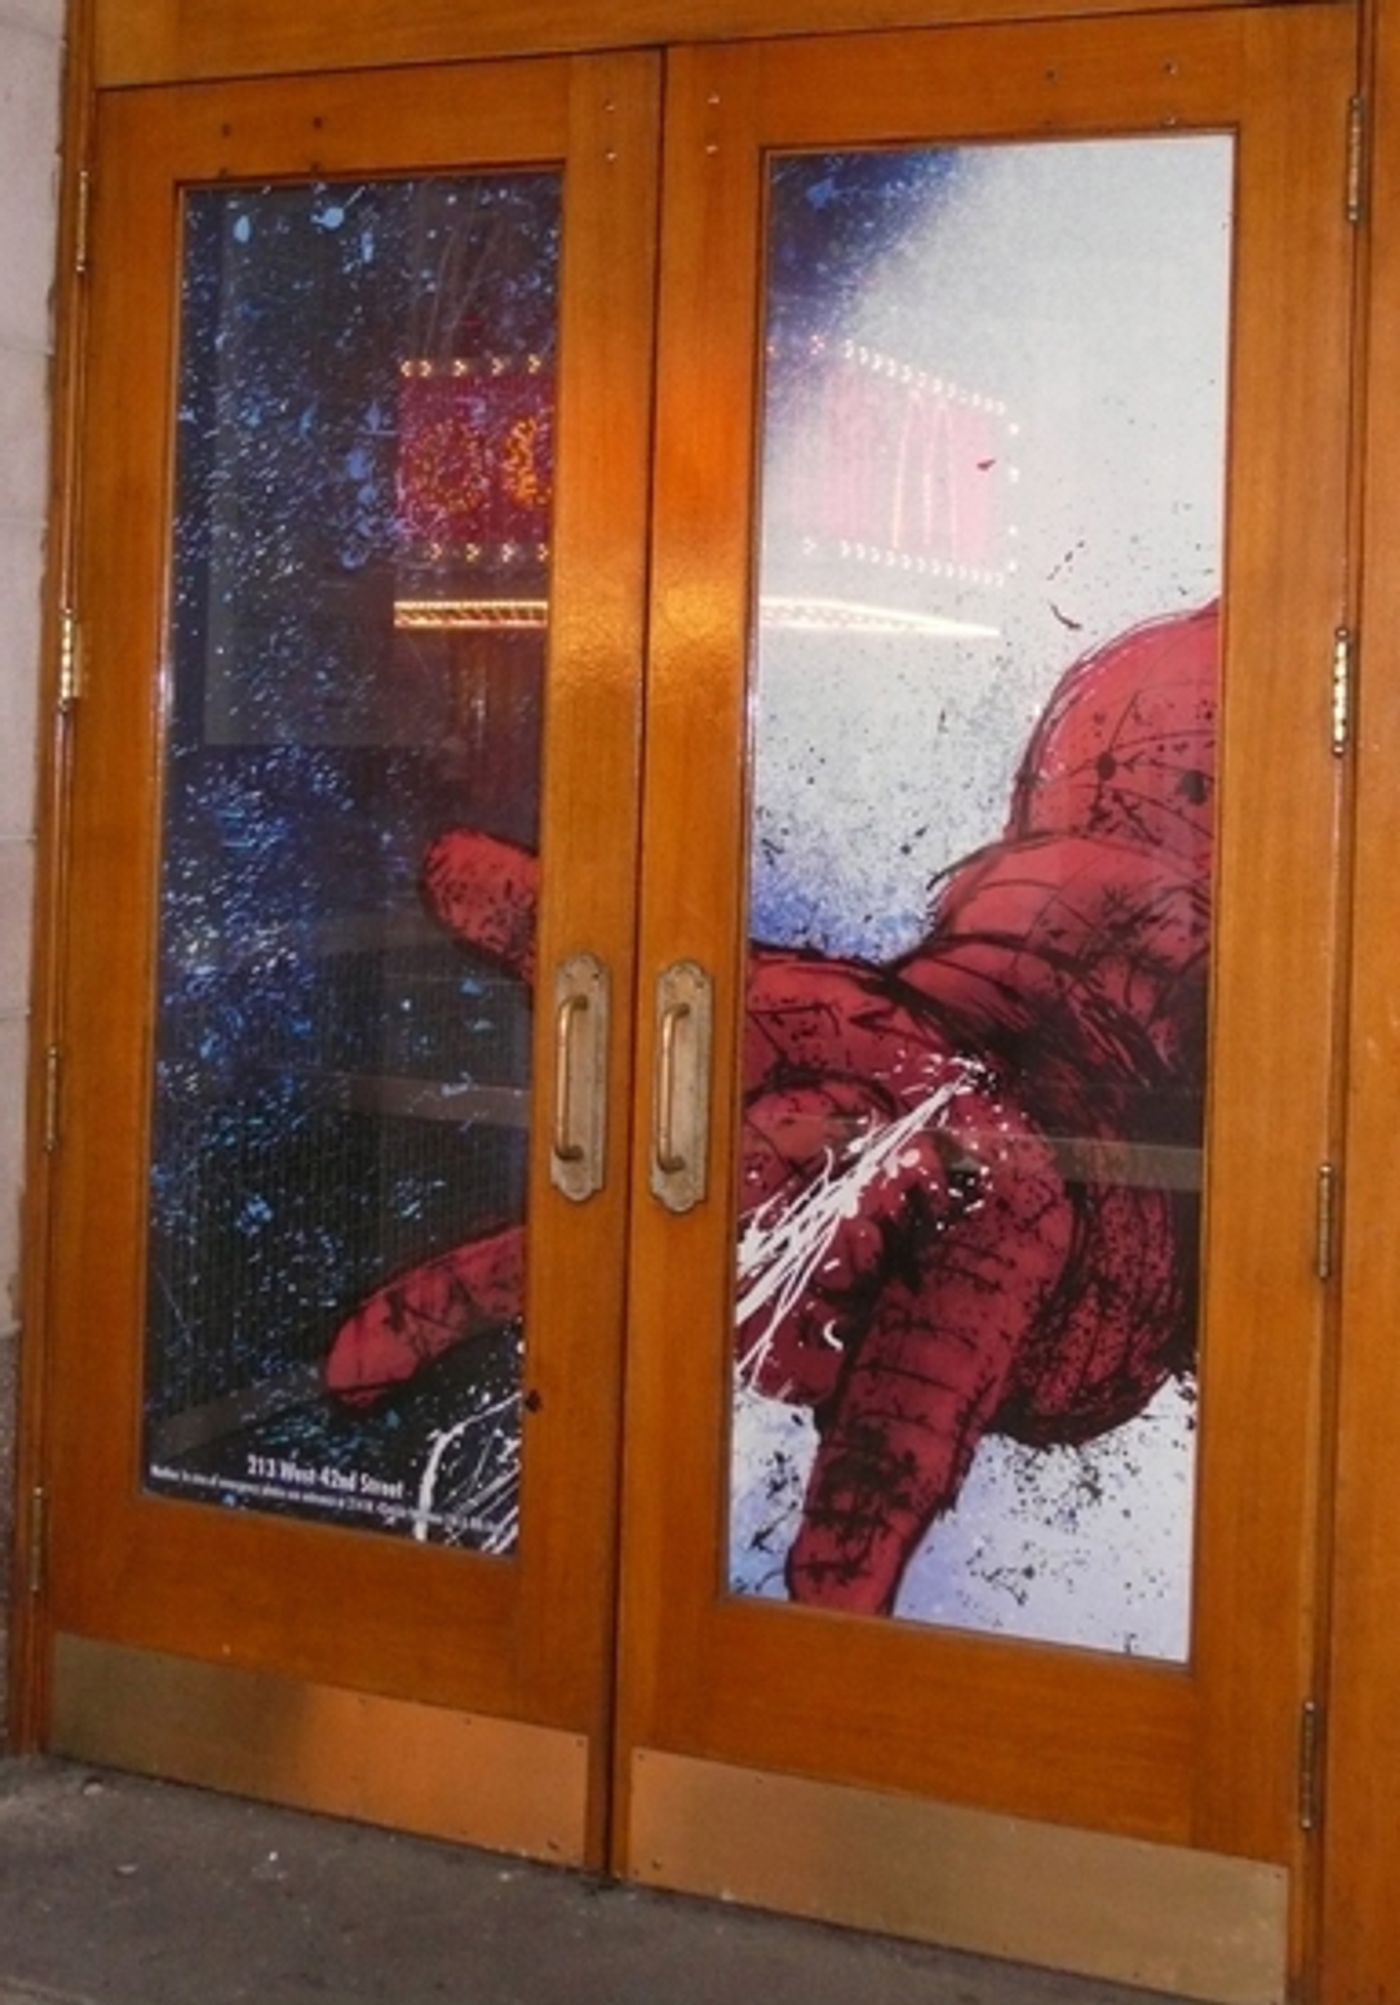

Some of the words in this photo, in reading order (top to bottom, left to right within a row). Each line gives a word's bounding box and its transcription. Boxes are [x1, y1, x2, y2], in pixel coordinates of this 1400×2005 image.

[247, 1454, 276, 1479] 213
[280, 1458, 316, 1485] West
[319, 1465, 358, 1492] 42nd
[360, 1472, 404, 1499] Street
